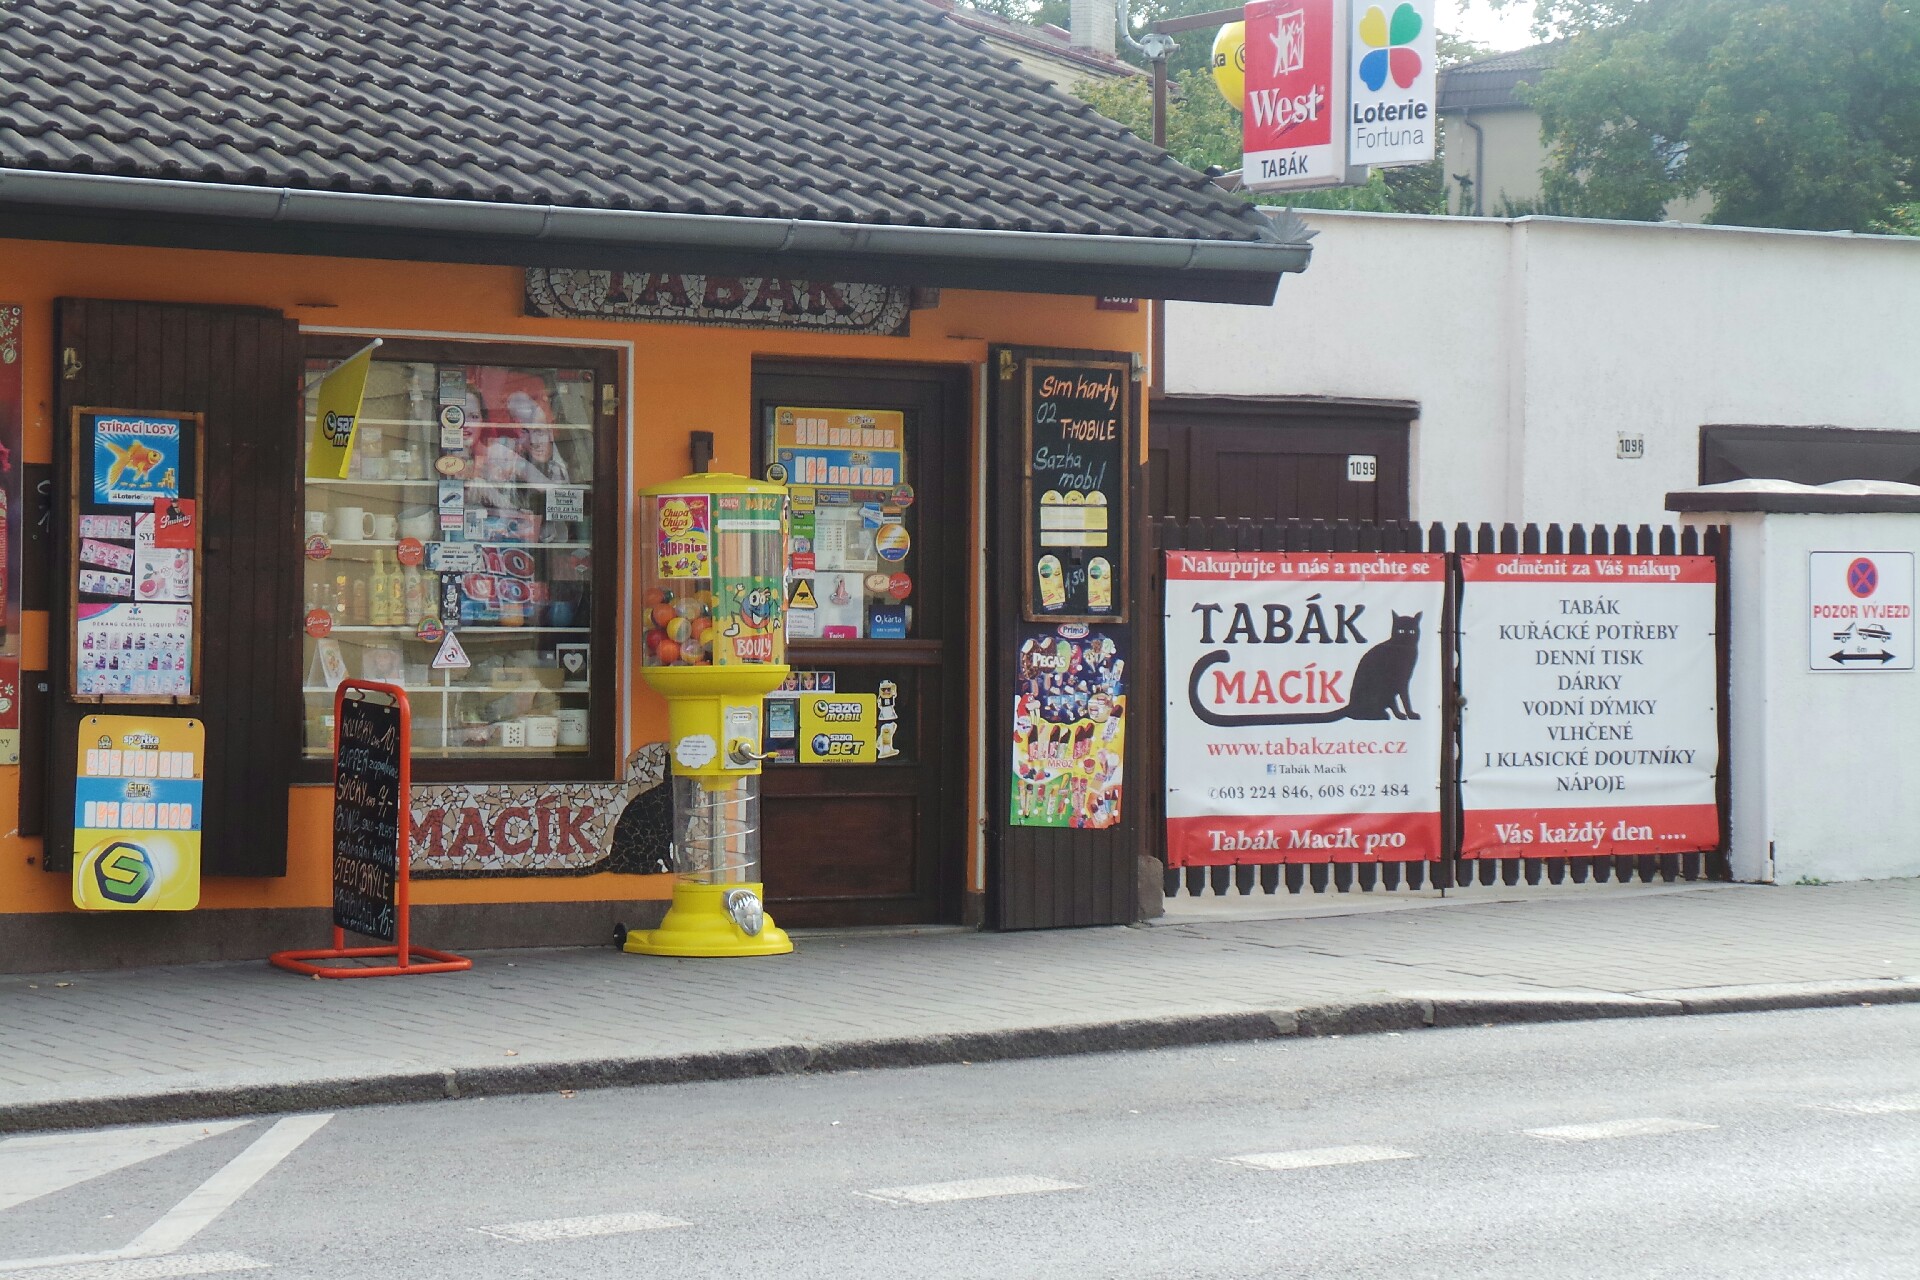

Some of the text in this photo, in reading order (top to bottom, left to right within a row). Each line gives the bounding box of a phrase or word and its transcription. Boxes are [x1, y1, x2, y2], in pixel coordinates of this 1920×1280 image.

[1249, 84, 1324, 127] West
[1354, 99, 1428, 124] Loterie
[1357, 126, 1424, 148] Fortuna
[1261, 152, 1308, 178] TABÁK
[99, 421, 174, 435] STÍRACÍ LOSY
[1060, 418, 1116, 441] T-MOBILE
[1350, 461, 1376, 476] 1099
[663, 508, 689, 519] Chupa
[662, 517, 688, 532] Chups
[660, 541, 708, 558] SURPRISE
[1181, 557, 1430, 579] Nakupujte u nás a nechte se
[1496, 558, 1681, 581] odměnit za Váš nákup
[1559, 595, 1621, 615] TABÁK
[1813, 604, 1859, 619] POZOR
[1191, 593, 1369, 644] TABÁK
[1062, 625, 1084, 635] Prima
[1499, 620, 1679, 640] KUŘÁCKÉ POTŘEBY
[737, 638, 772, 657] BOULY
[1535, 646, 1644, 666] DENNÍ TISK
[1032, 652, 1066, 668] PEGAS
[1213, 662, 1346, 705] MACÍK
[1558, 671, 1623, 691] DÁRKY
[827, 702, 862, 714] sazka
[1522, 695, 1658, 716] VODNÍ DÝMKY
[123, 734, 160, 746] sportka
[1547, 721, 1634, 741] VLHČENÉ
[1206, 737, 1408, 757] www.tabakzatec.cz
[1485, 745, 1696, 768] I KLASICKÉ DOUTNÍKY
[1219, 783, 1410, 800] 603 224 846, 608 622 484
[1556, 772, 1626, 793] NÁPOJE
[409, 795, 598, 857] MACÍK
[1495, 823, 1534, 844] Vás
[1540, 822, 1607, 848] každý
[1612, 820, 1653, 841] den
[1208, 827, 1406, 855] Tabák Macík pro
